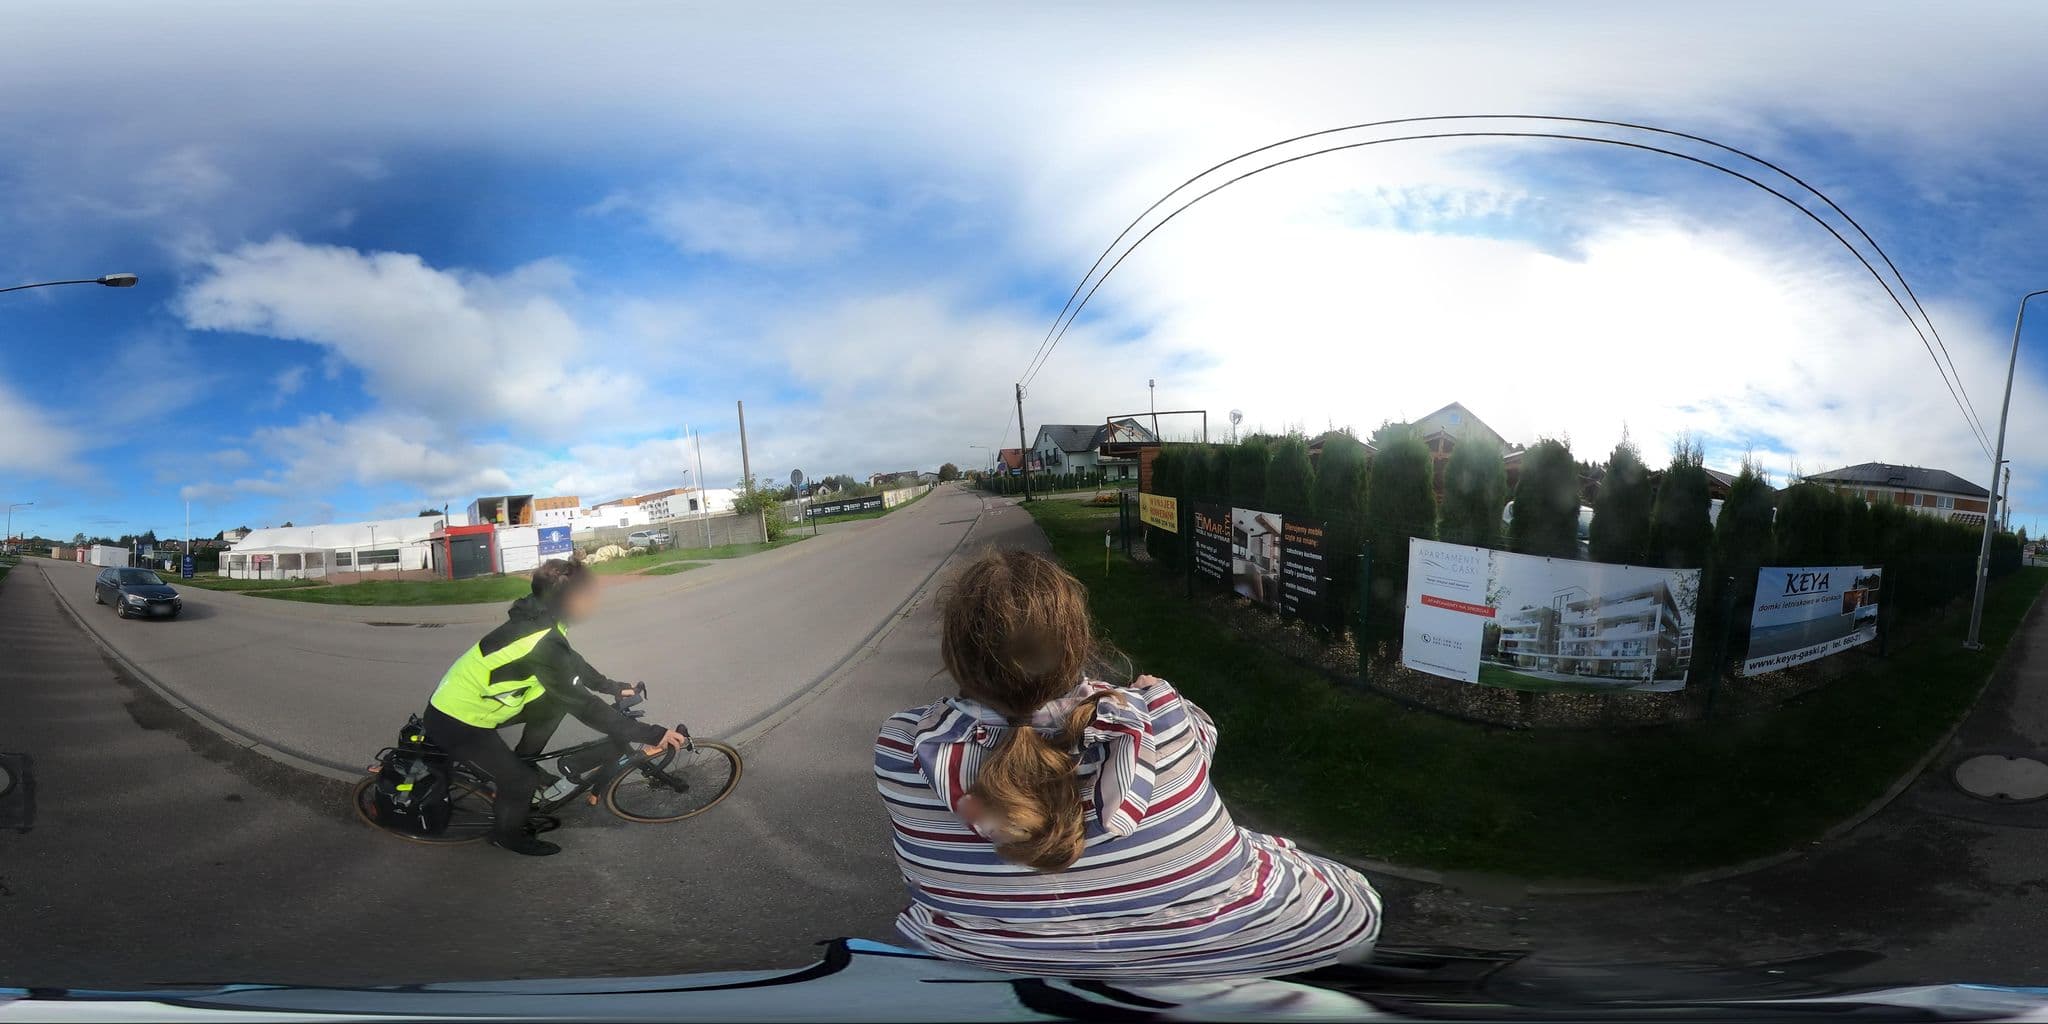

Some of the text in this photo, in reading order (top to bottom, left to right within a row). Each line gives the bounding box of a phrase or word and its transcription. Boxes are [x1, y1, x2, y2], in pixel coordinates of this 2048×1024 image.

[1419, 548, 1480, 563] APARTAMENTY
[1785, 572, 1829, 594] KEYA
[1758, 601, 1781, 612] domki
[1782, 597, 1814, 609] letniskowe
[1749, 645, 1828, 669] www.keya-gaski.pl
